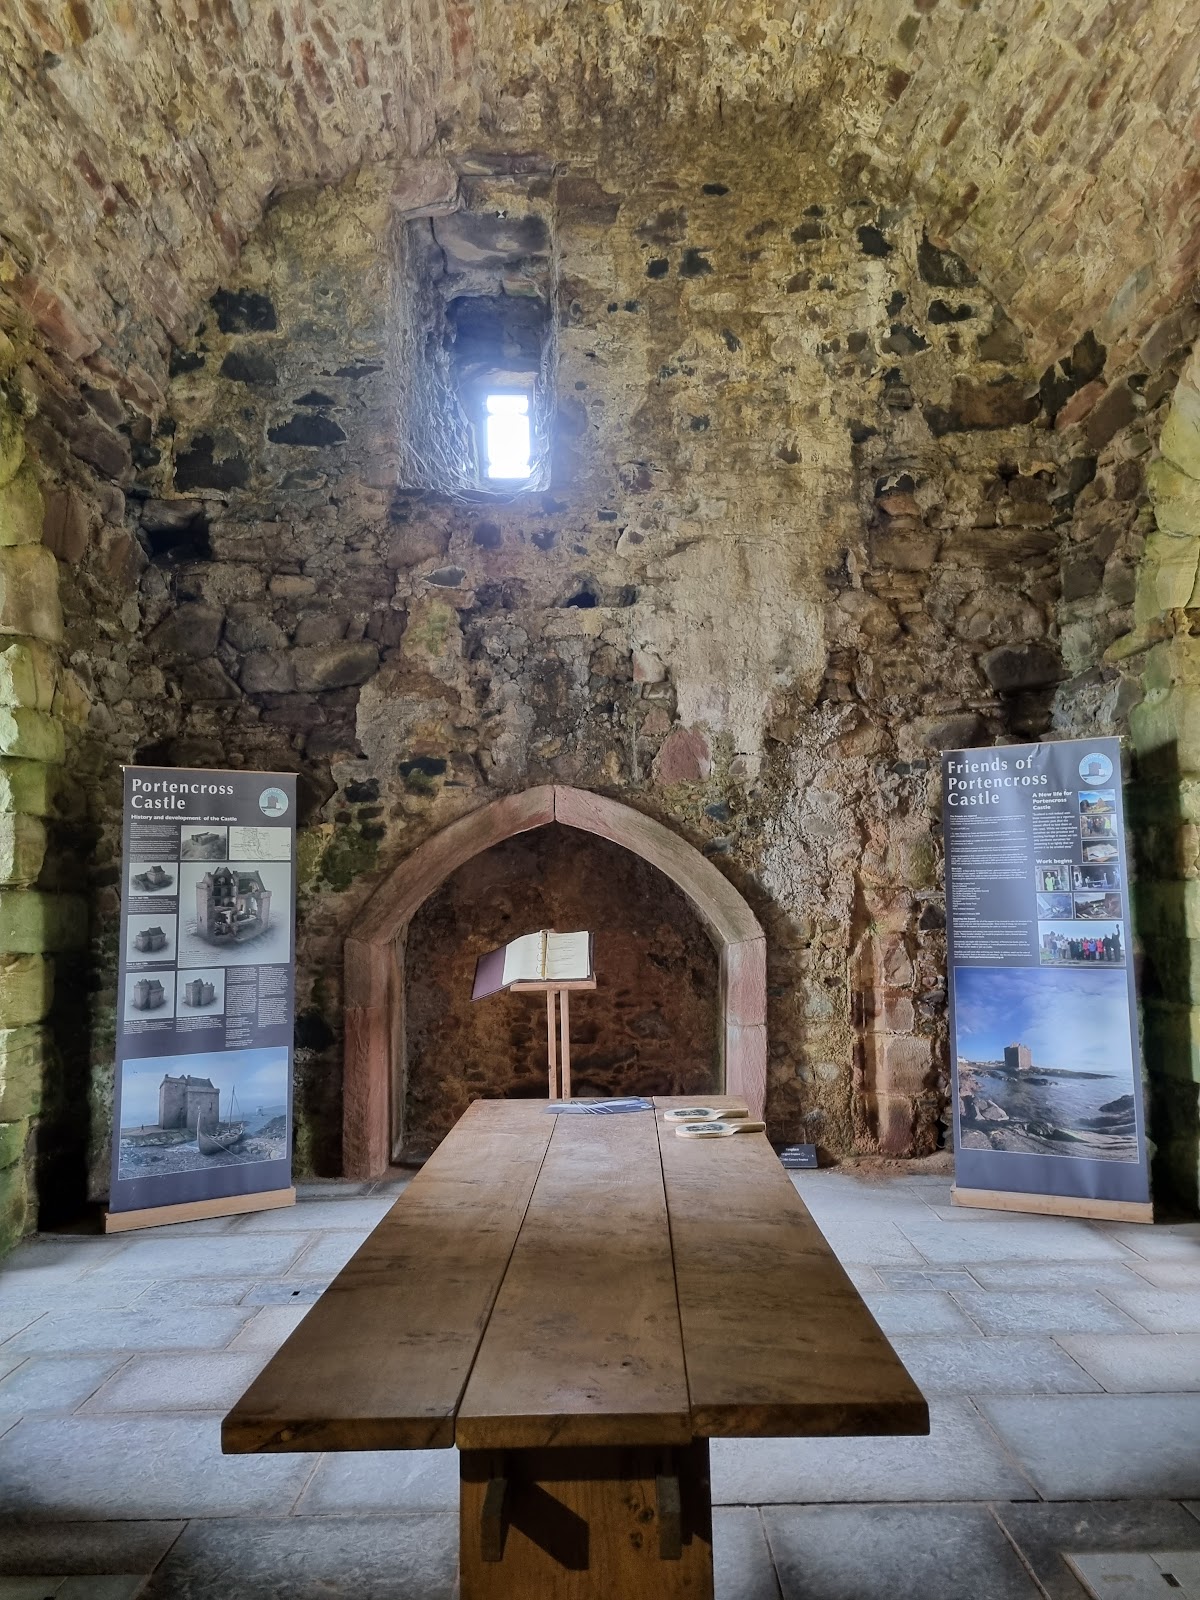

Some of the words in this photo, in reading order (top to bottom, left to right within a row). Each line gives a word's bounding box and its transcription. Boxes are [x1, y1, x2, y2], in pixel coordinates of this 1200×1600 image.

[948, 757, 1008, 774] Friends
[1016, 755, 1033, 770] of
[132, 778, 234, 795] Portencross
[948, 774, 1048, 790] Portencross
[131, 795, 186, 809] Castle
[948, 791, 1000, 806] Castle
